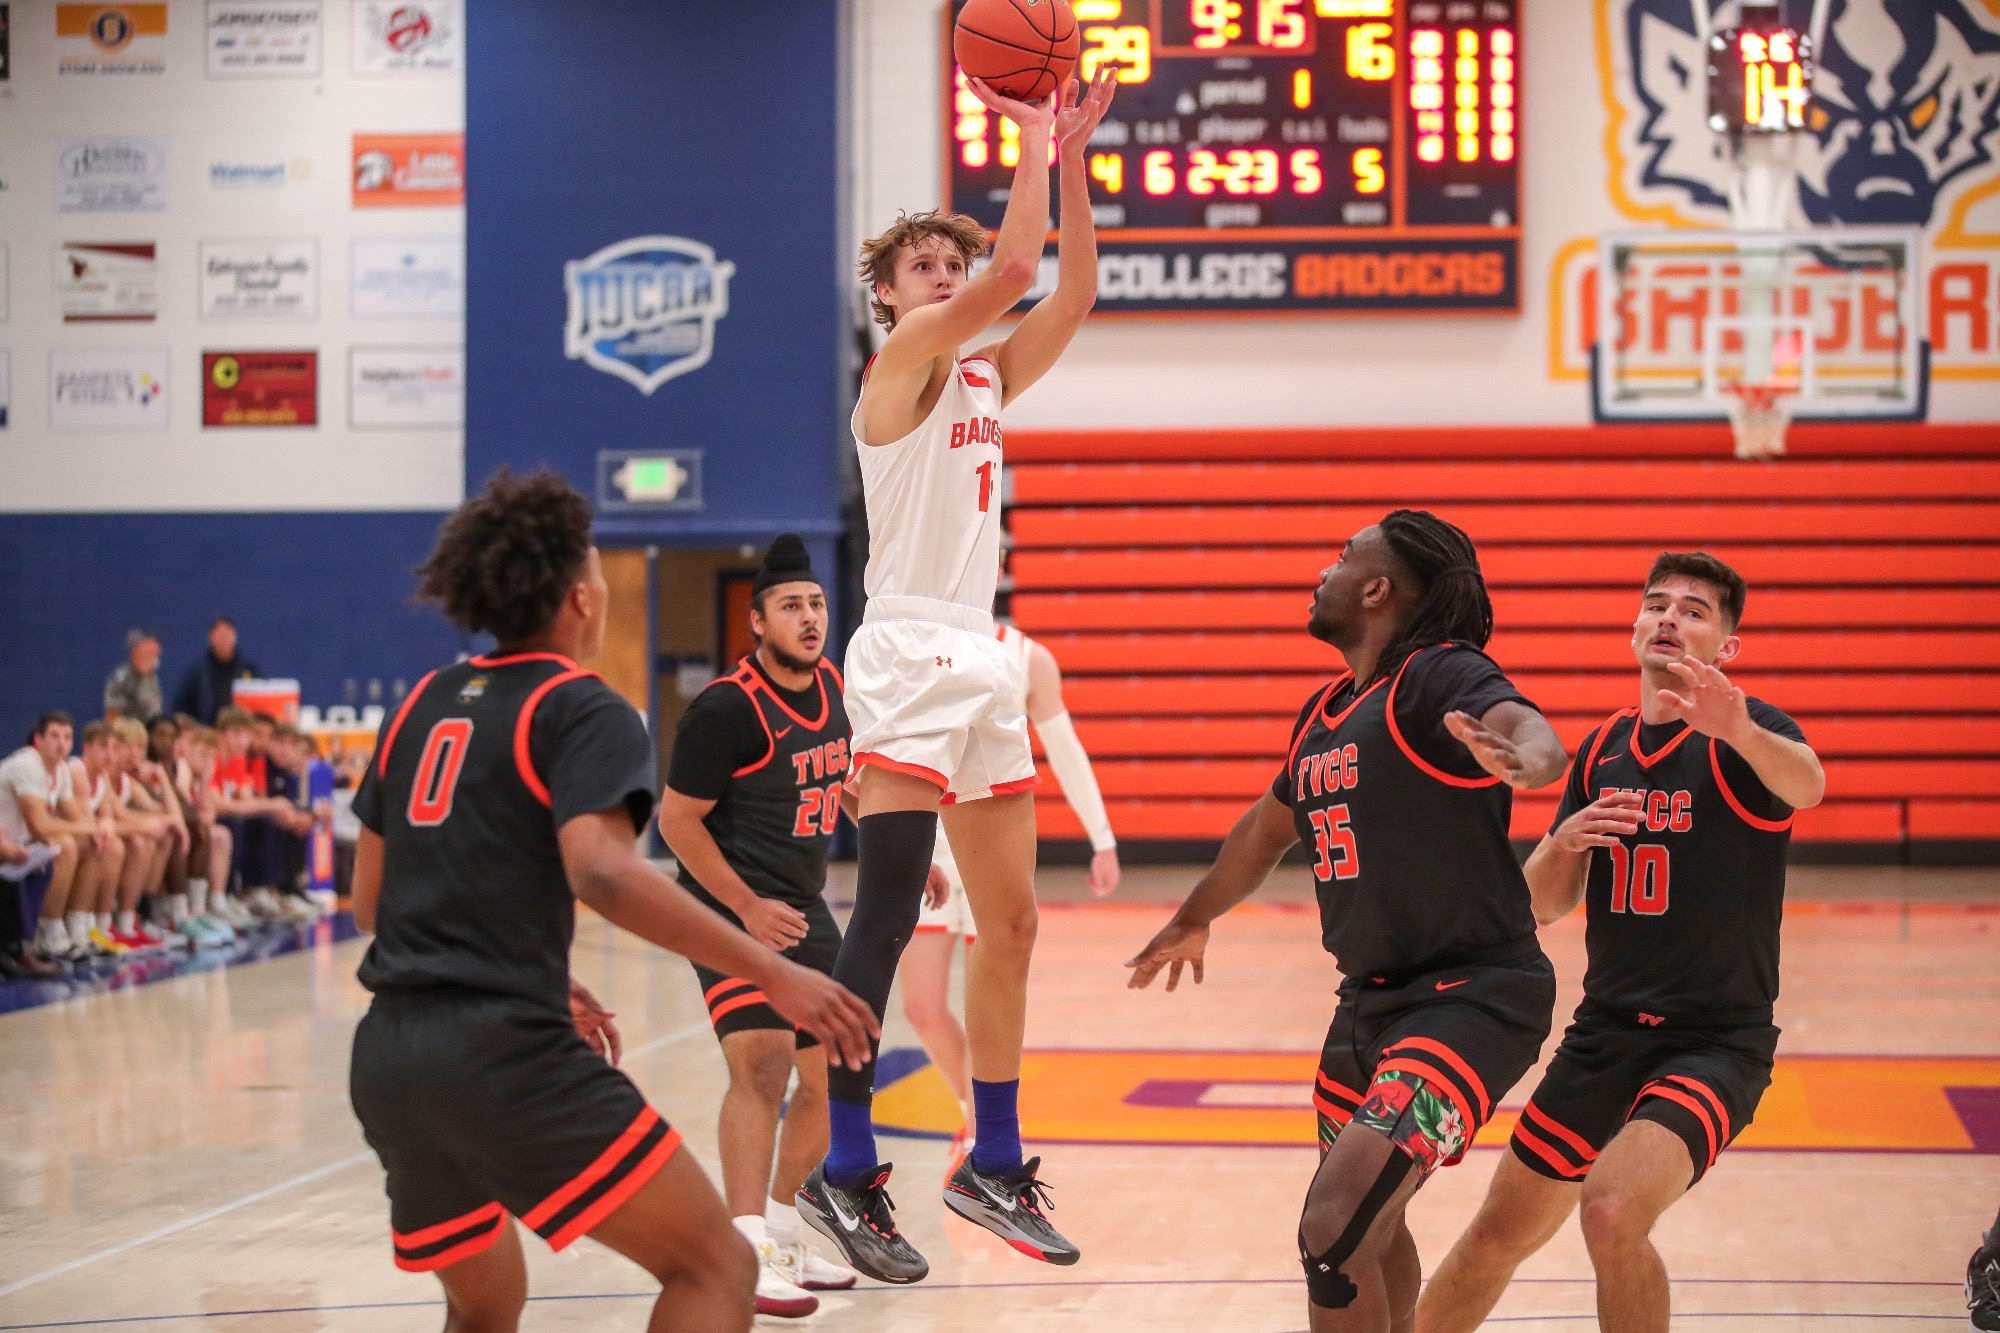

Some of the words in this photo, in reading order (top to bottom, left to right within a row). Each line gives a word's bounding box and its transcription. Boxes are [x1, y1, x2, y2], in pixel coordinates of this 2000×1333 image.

[1080, 25, 1151, 83] 29
[1346, 23, 1395, 80] 16
[1745, 61, 1805, 127] 14
[1090, 153, 1124, 194] 4
[1143, 150, 1176, 195] 6
[1098, 253, 1287, 299] COLLEGE
[1293, 253, 1505, 298] BADGERS
[406, 717, 474, 827] 0
[792, 738, 850, 785] TVCC
[1297, 743, 1358, 802] TVCC
[792, 780, 842, 836] 20
[1308, 803, 1359, 882] 35
[1610, 842, 1670, 916] 10
